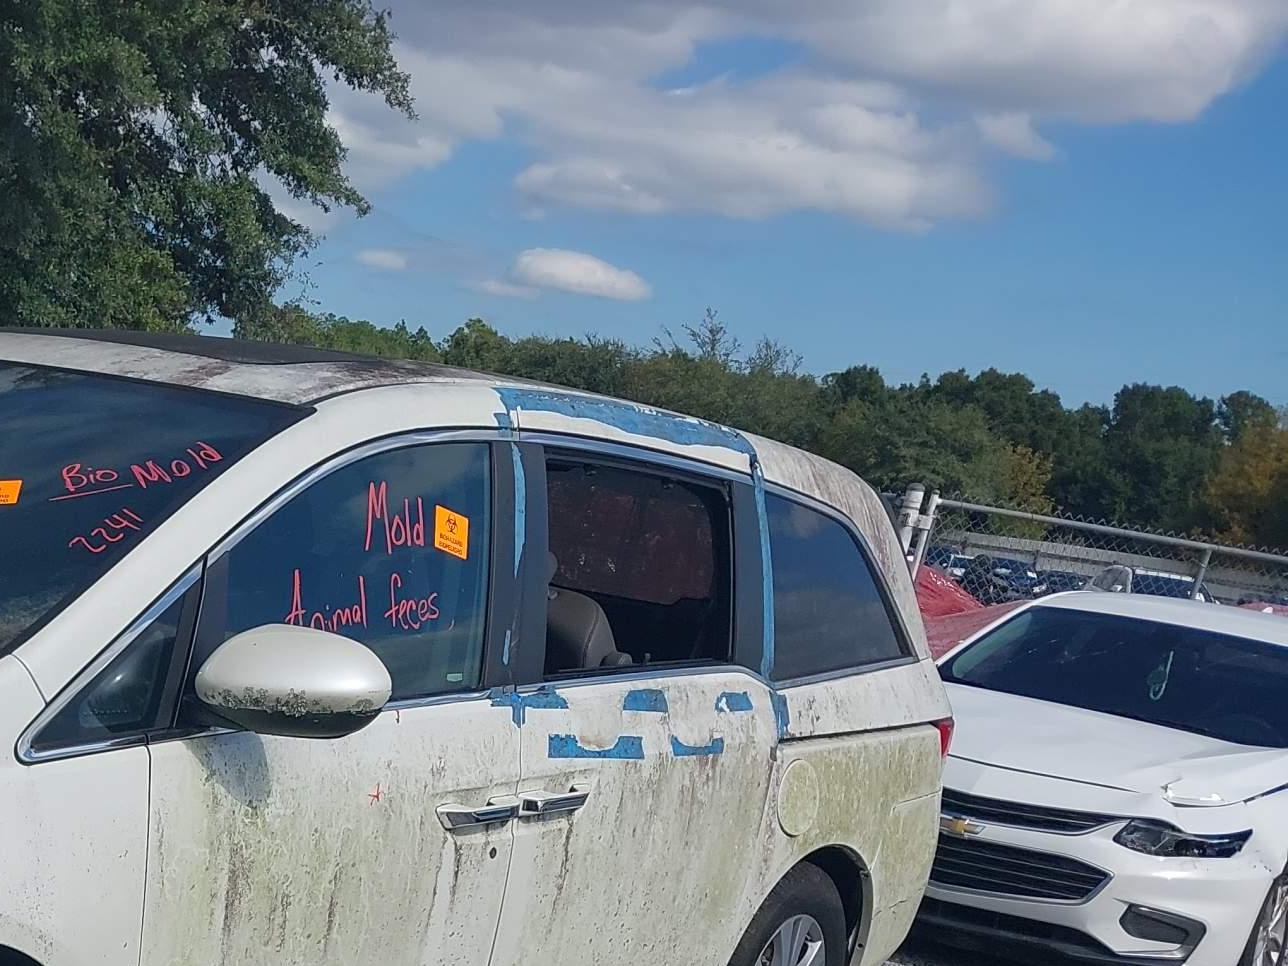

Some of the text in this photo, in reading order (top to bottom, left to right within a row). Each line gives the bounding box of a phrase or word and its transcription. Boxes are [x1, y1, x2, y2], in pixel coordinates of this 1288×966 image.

[62, 441, 223, 492] Bio Mold
[68, 508, 144, 552] 2241
[364, 481, 424, 554] Mold
[384, 573, 440, 630] feces
